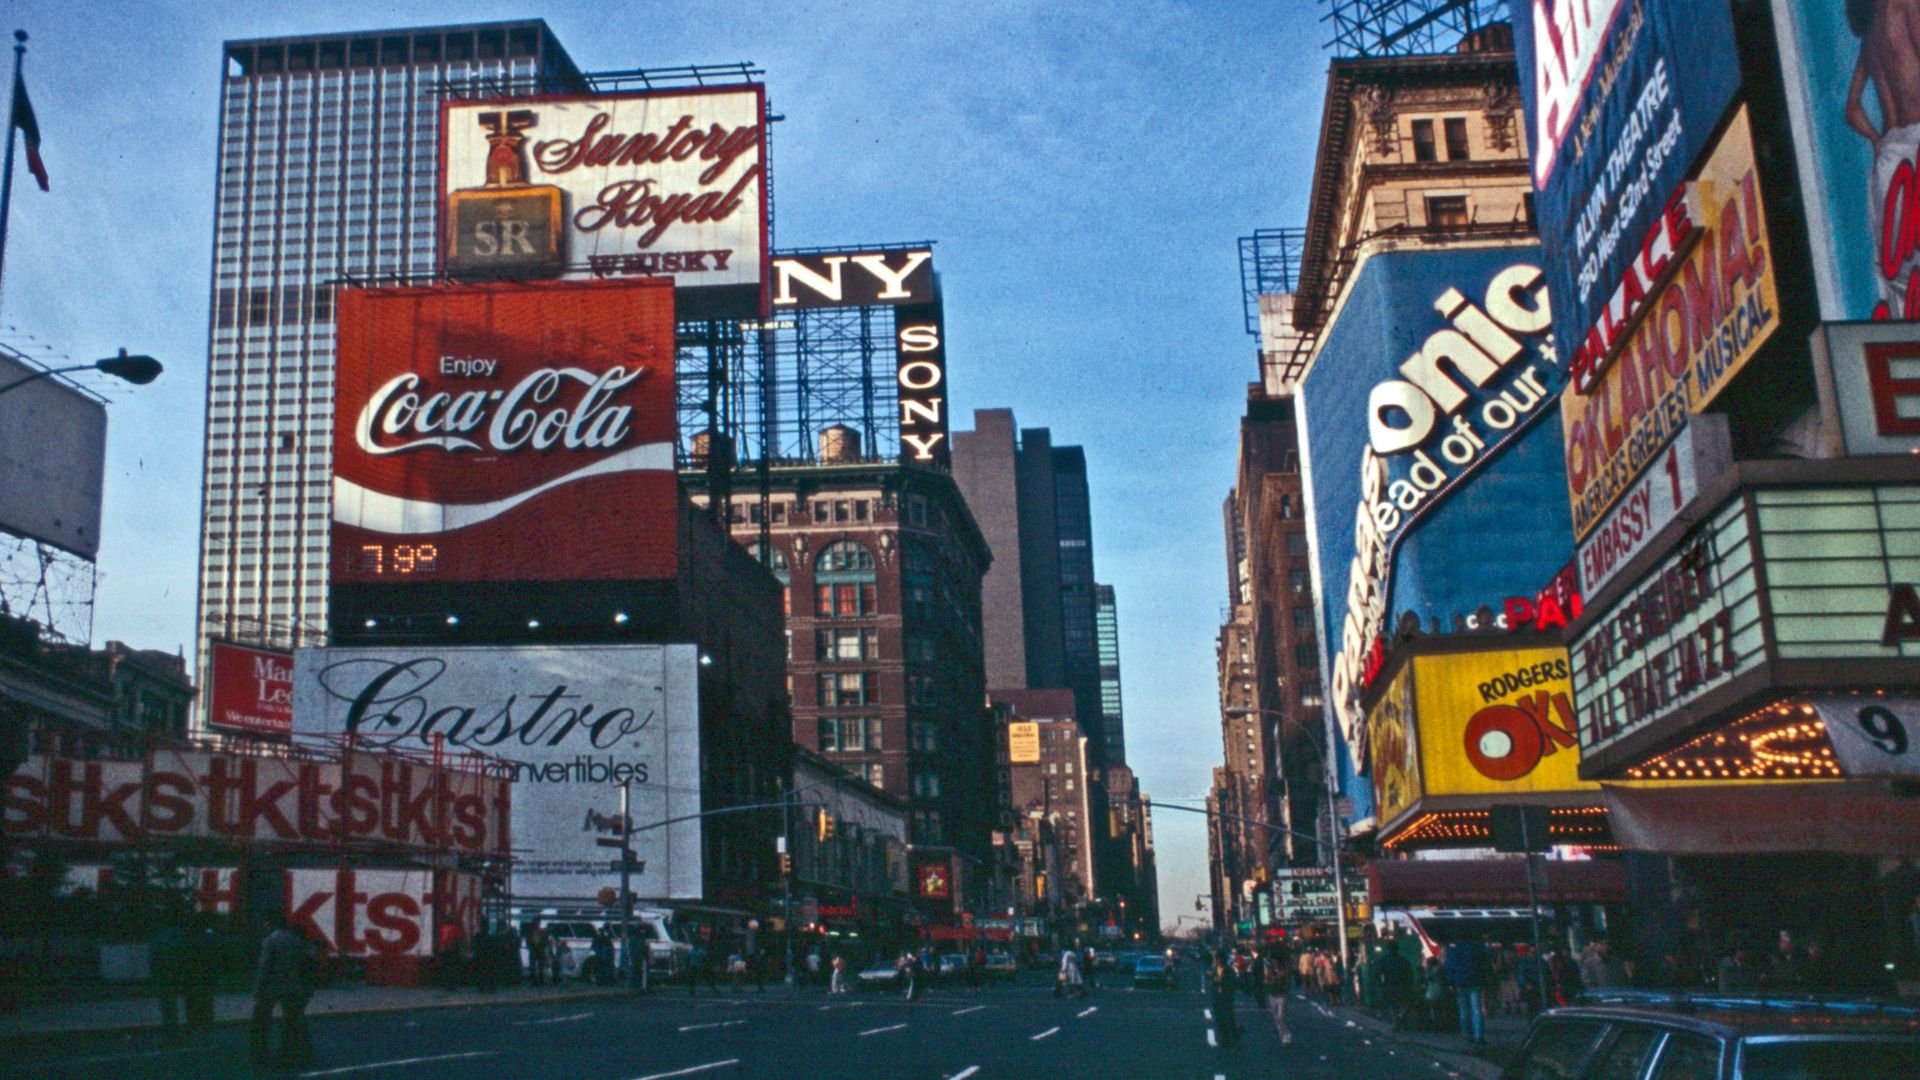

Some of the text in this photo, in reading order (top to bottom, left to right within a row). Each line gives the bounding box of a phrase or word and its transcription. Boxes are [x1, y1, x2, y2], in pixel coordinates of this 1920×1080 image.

[533, 112, 760, 186] Suntory
[1574, 57, 1670, 258] ALVIN THEATRE
[1645, 107, 1683, 181] Street
[473, 219, 536, 256] SR
[574, 164, 762, 249] Royal
[588, 249, 733, 276] WHISKY
[1571, 181, 1693, 396] PALACE
[440, 355, 498, 376] Enjoy
[1566, 168, 1766, 495] OKLAHOMA!
[355, 366, 644, 455] Coca-Cola
[899, 325, 944, 460] SONY
[1441, 414, 1486, 465] of
[1482, 365, 1548, 430] our
[1573, 284, 1772, 533] AMERICA'S GREATEST MUSICAL
[1582, 479, 1652, 592] EMBASSY
[1665, 444, 1684, 512] 1
[319, 657, 655, 748] Castro
[1478, 658, 1569, 704] RODGERS
[1587, 603, 1737, 744] ALL THAT JAZZ
